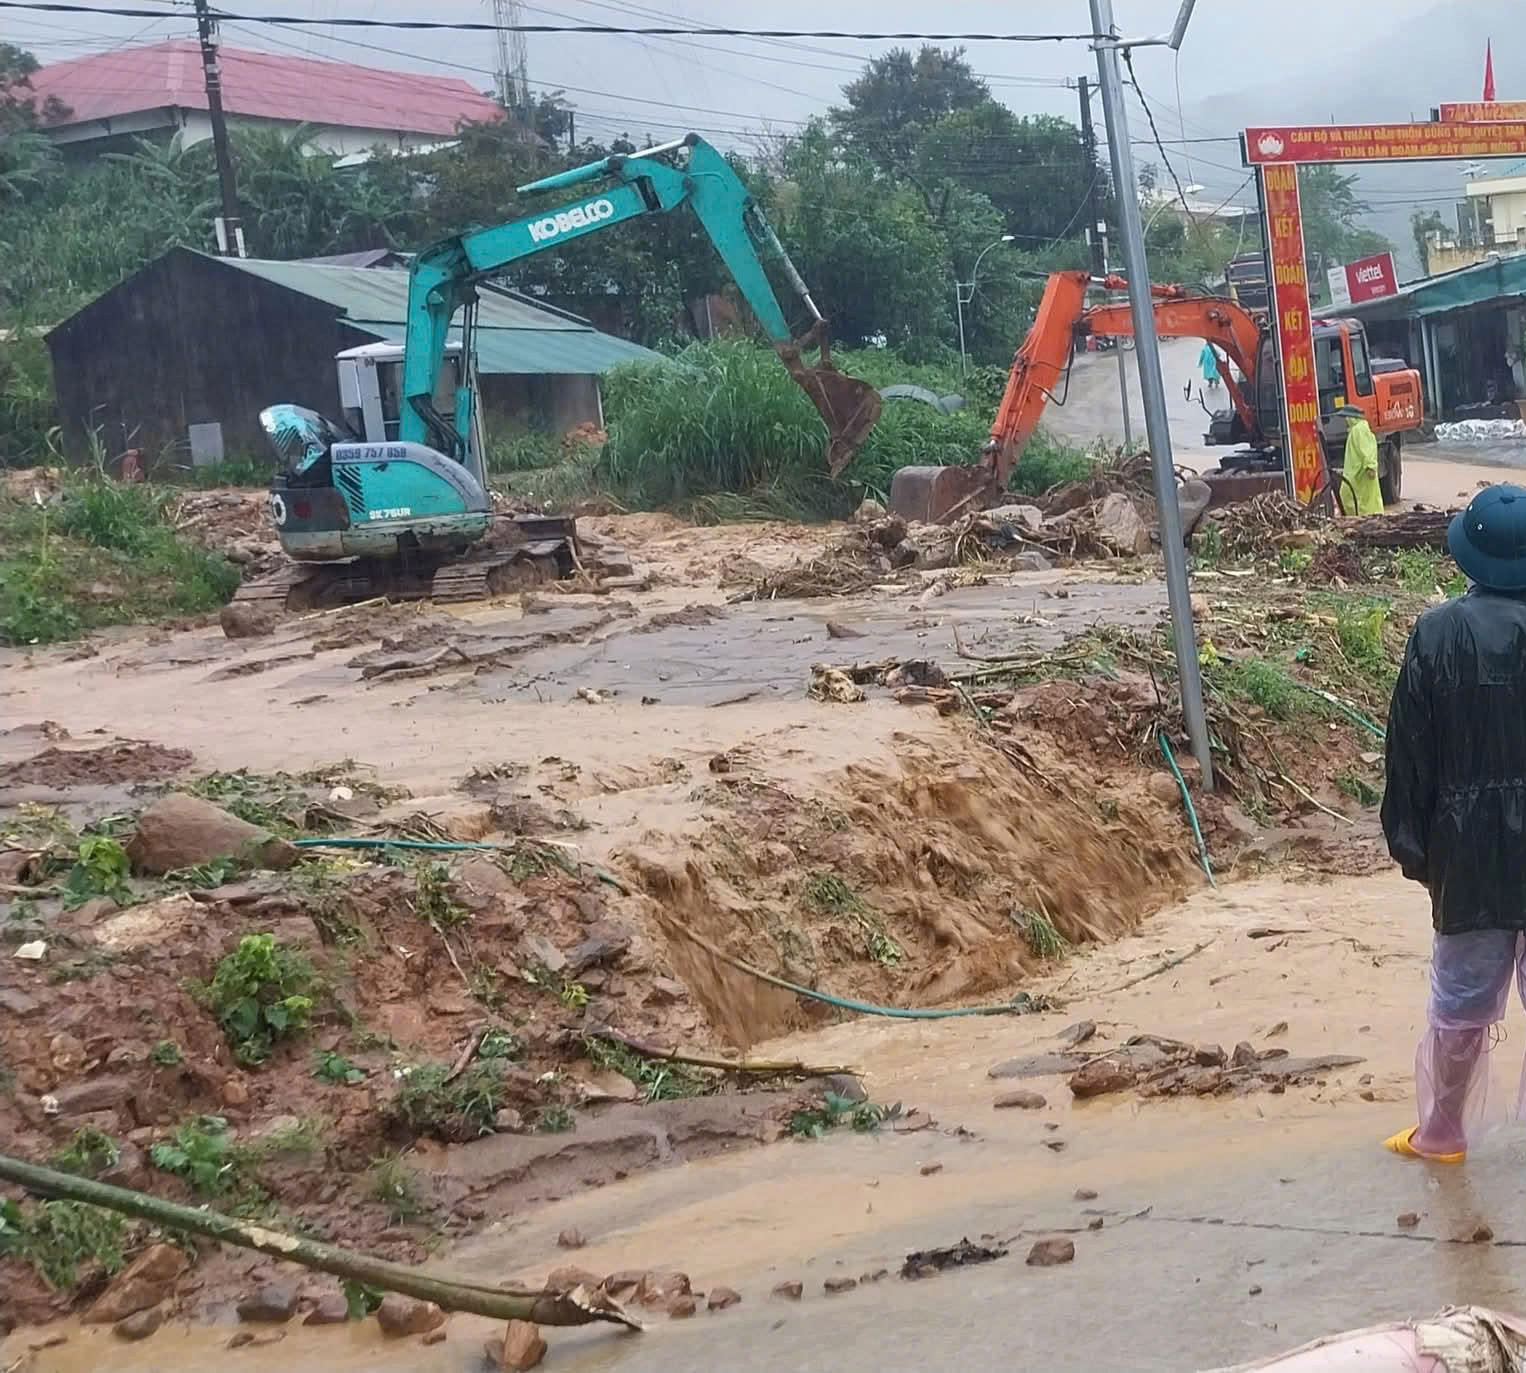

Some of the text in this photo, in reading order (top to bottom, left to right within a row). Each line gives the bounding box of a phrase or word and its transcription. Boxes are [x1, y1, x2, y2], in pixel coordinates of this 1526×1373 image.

[528, 199, 614, 242] KOBELCO
[1355, 263, 1384, 284] viettel
[1284, 305, 1304, 331] KẾT
